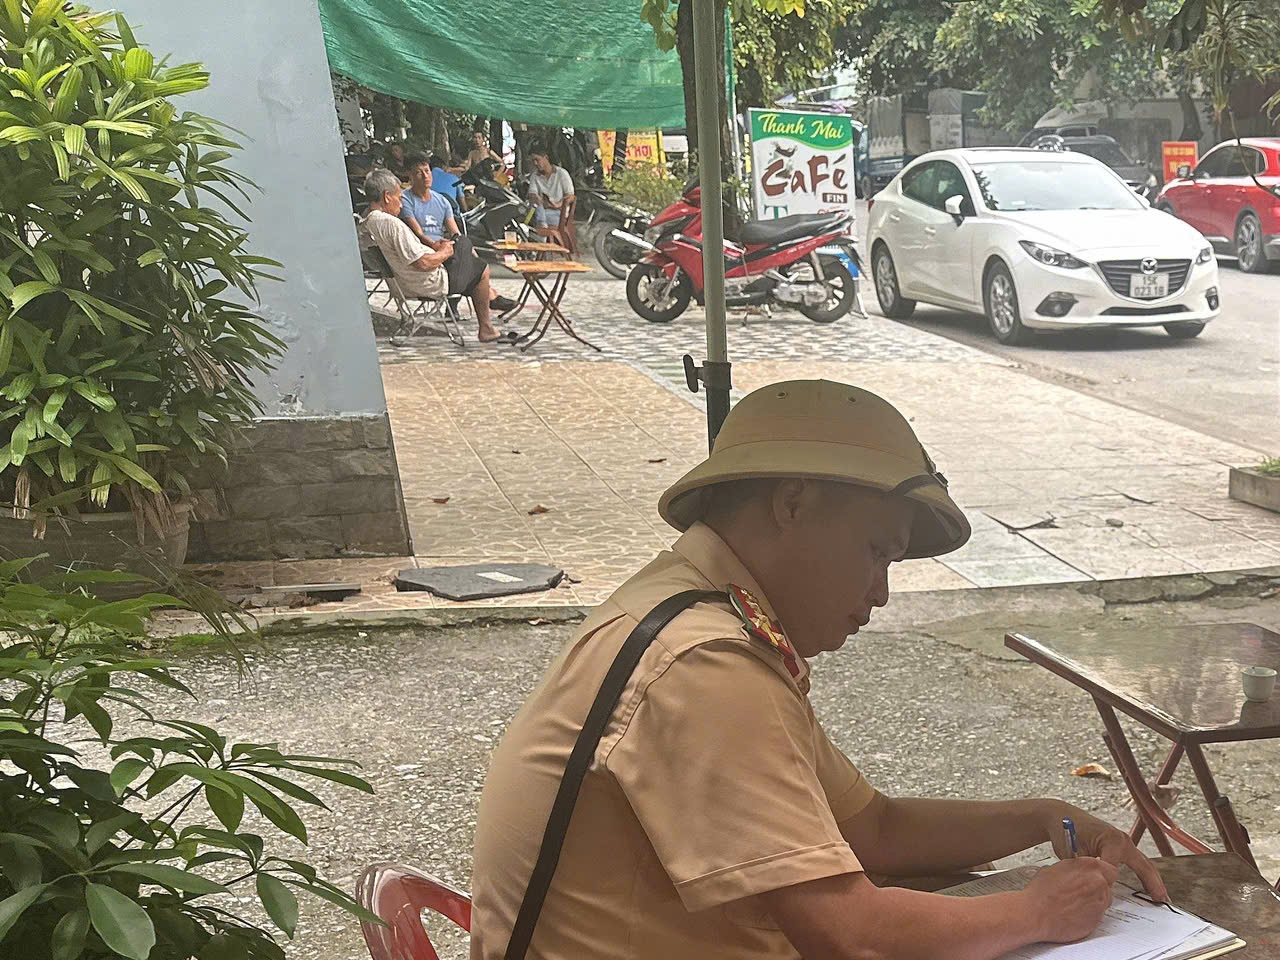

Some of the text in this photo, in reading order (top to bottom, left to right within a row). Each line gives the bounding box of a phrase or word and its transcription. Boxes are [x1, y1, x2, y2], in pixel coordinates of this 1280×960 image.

[758, 113, 844, 139] Thanh Mai
[825, 195, 845, 203] FIN
